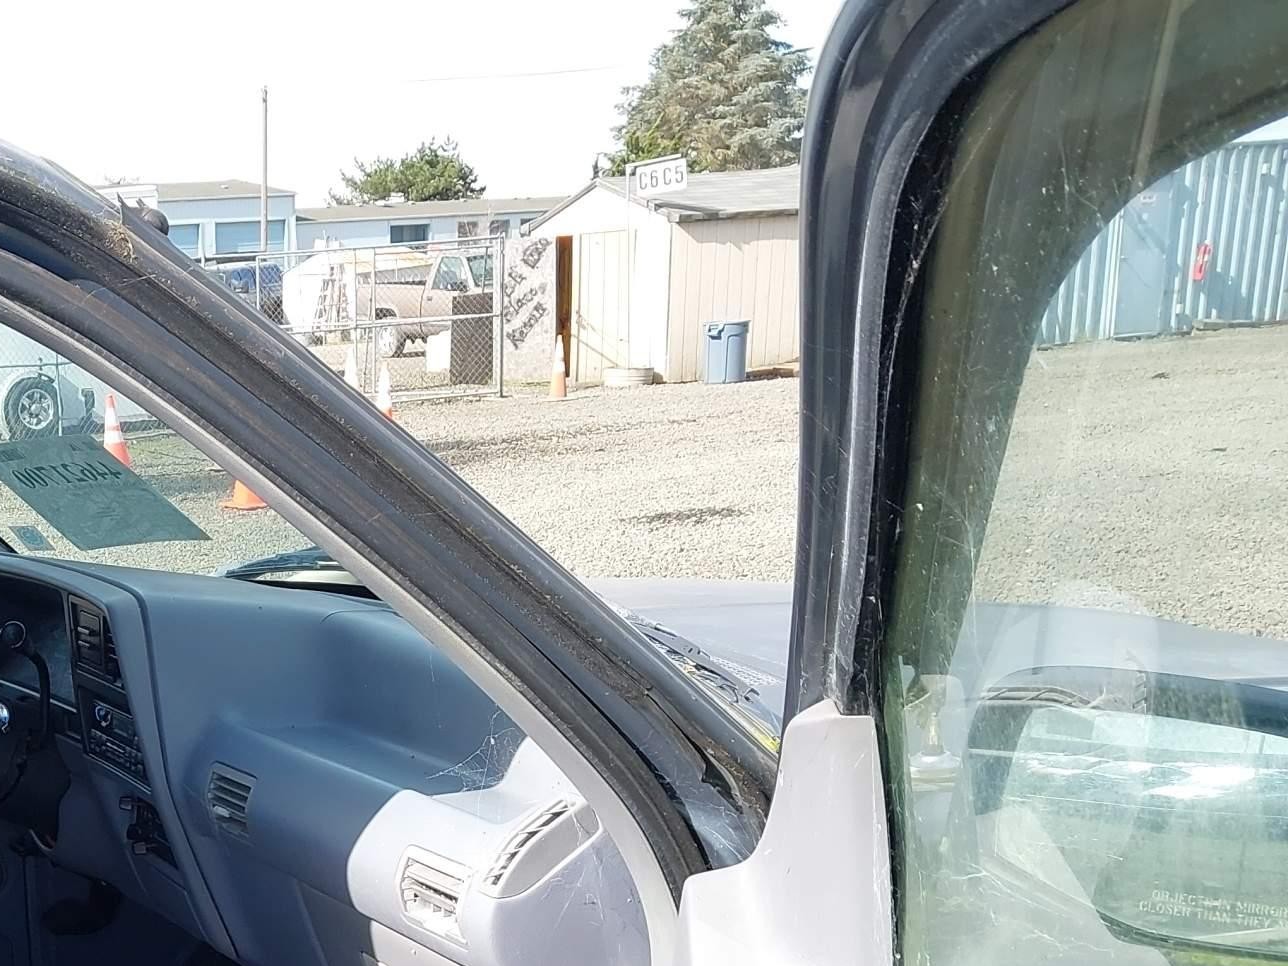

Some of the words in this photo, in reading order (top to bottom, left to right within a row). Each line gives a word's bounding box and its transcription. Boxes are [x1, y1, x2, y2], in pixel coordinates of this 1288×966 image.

[639, 170, 659, 190] C6
[663, 165, 684, 185] C5
[1138, 900, 1191, 917] CLOSER
[1196, 907, 1231, 924] THAN
[1237, 913, 1271, 929] THEY
